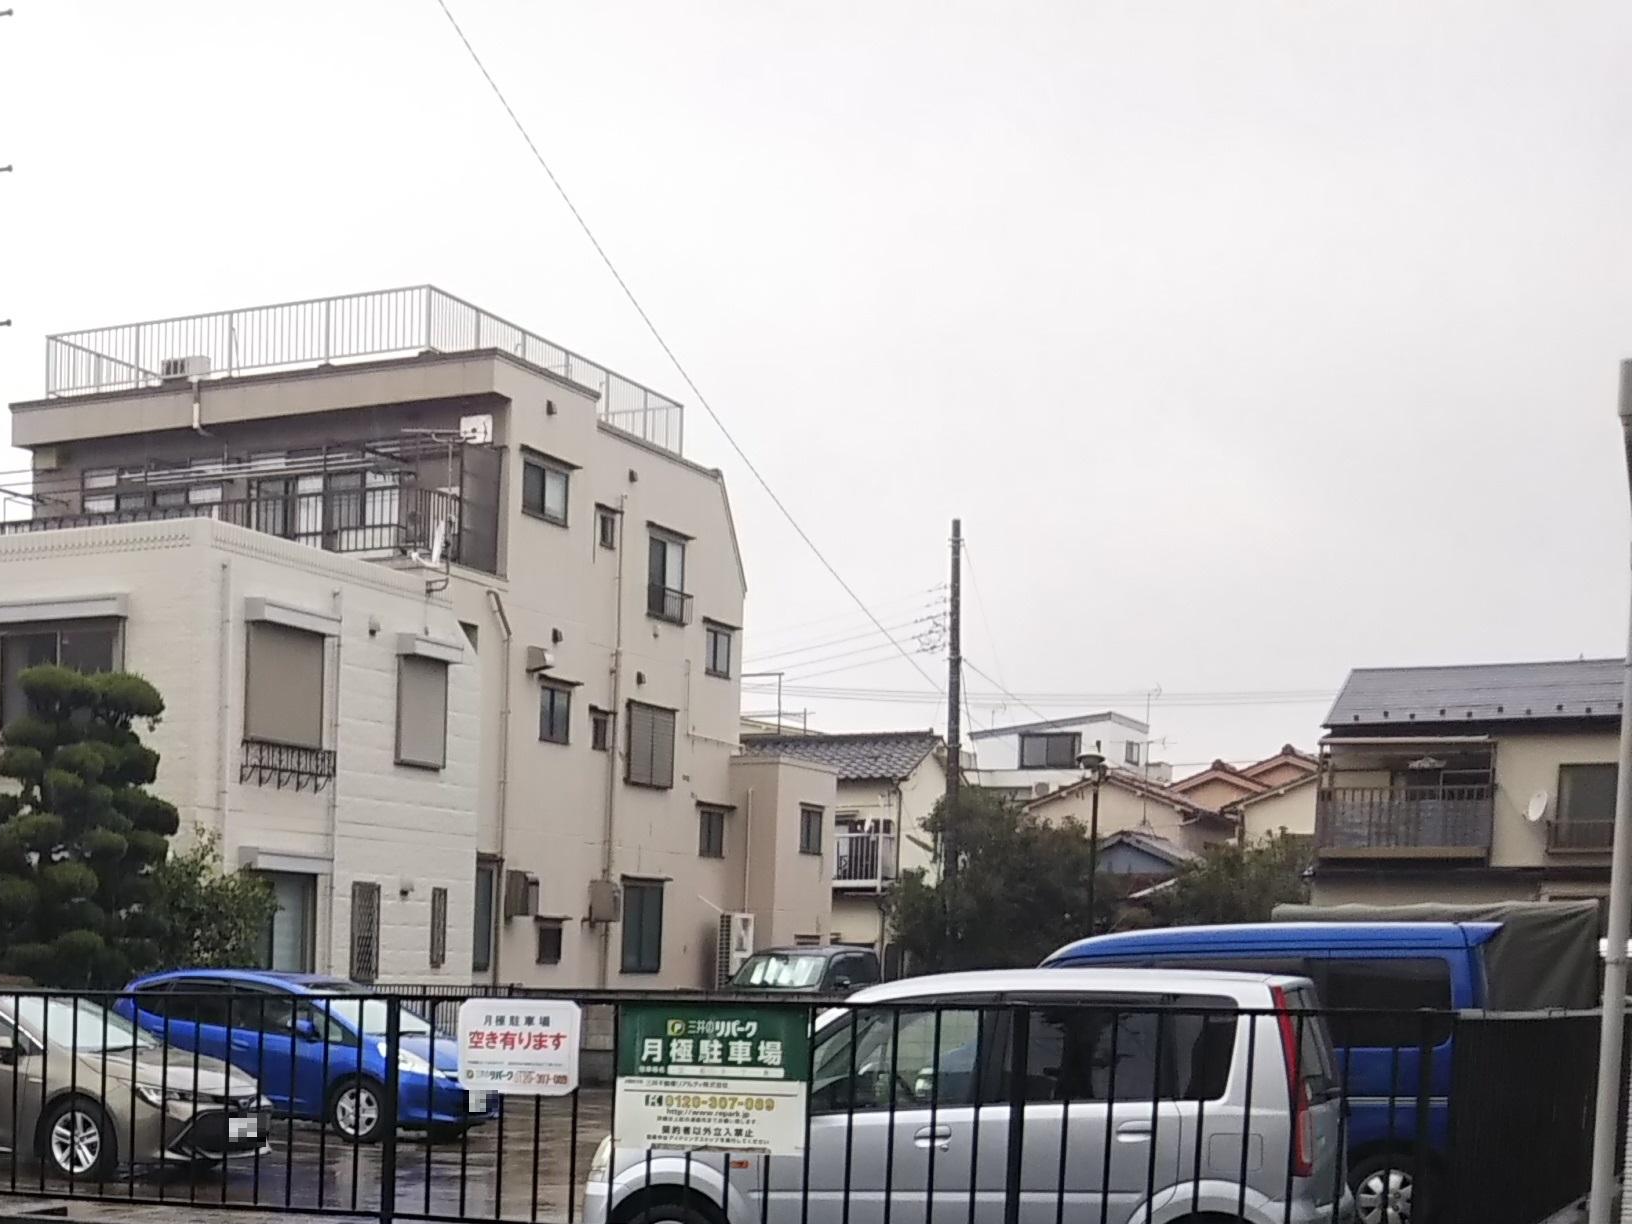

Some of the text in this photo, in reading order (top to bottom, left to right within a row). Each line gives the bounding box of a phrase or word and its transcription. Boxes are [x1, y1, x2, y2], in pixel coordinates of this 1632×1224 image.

[484, 1014, 551, 1027] 月極駐車場
[687, 1020, 758, 1037] 三井のリパーク
[468, 1030, 567, 1051] 空き有ります
[641, 1038, 783, 1065] 月極駐車場
[667, 1109, 750, 1119] http://www.repark.jp
[662, 1125, 754, 1137] 契約者以外立入禁止
